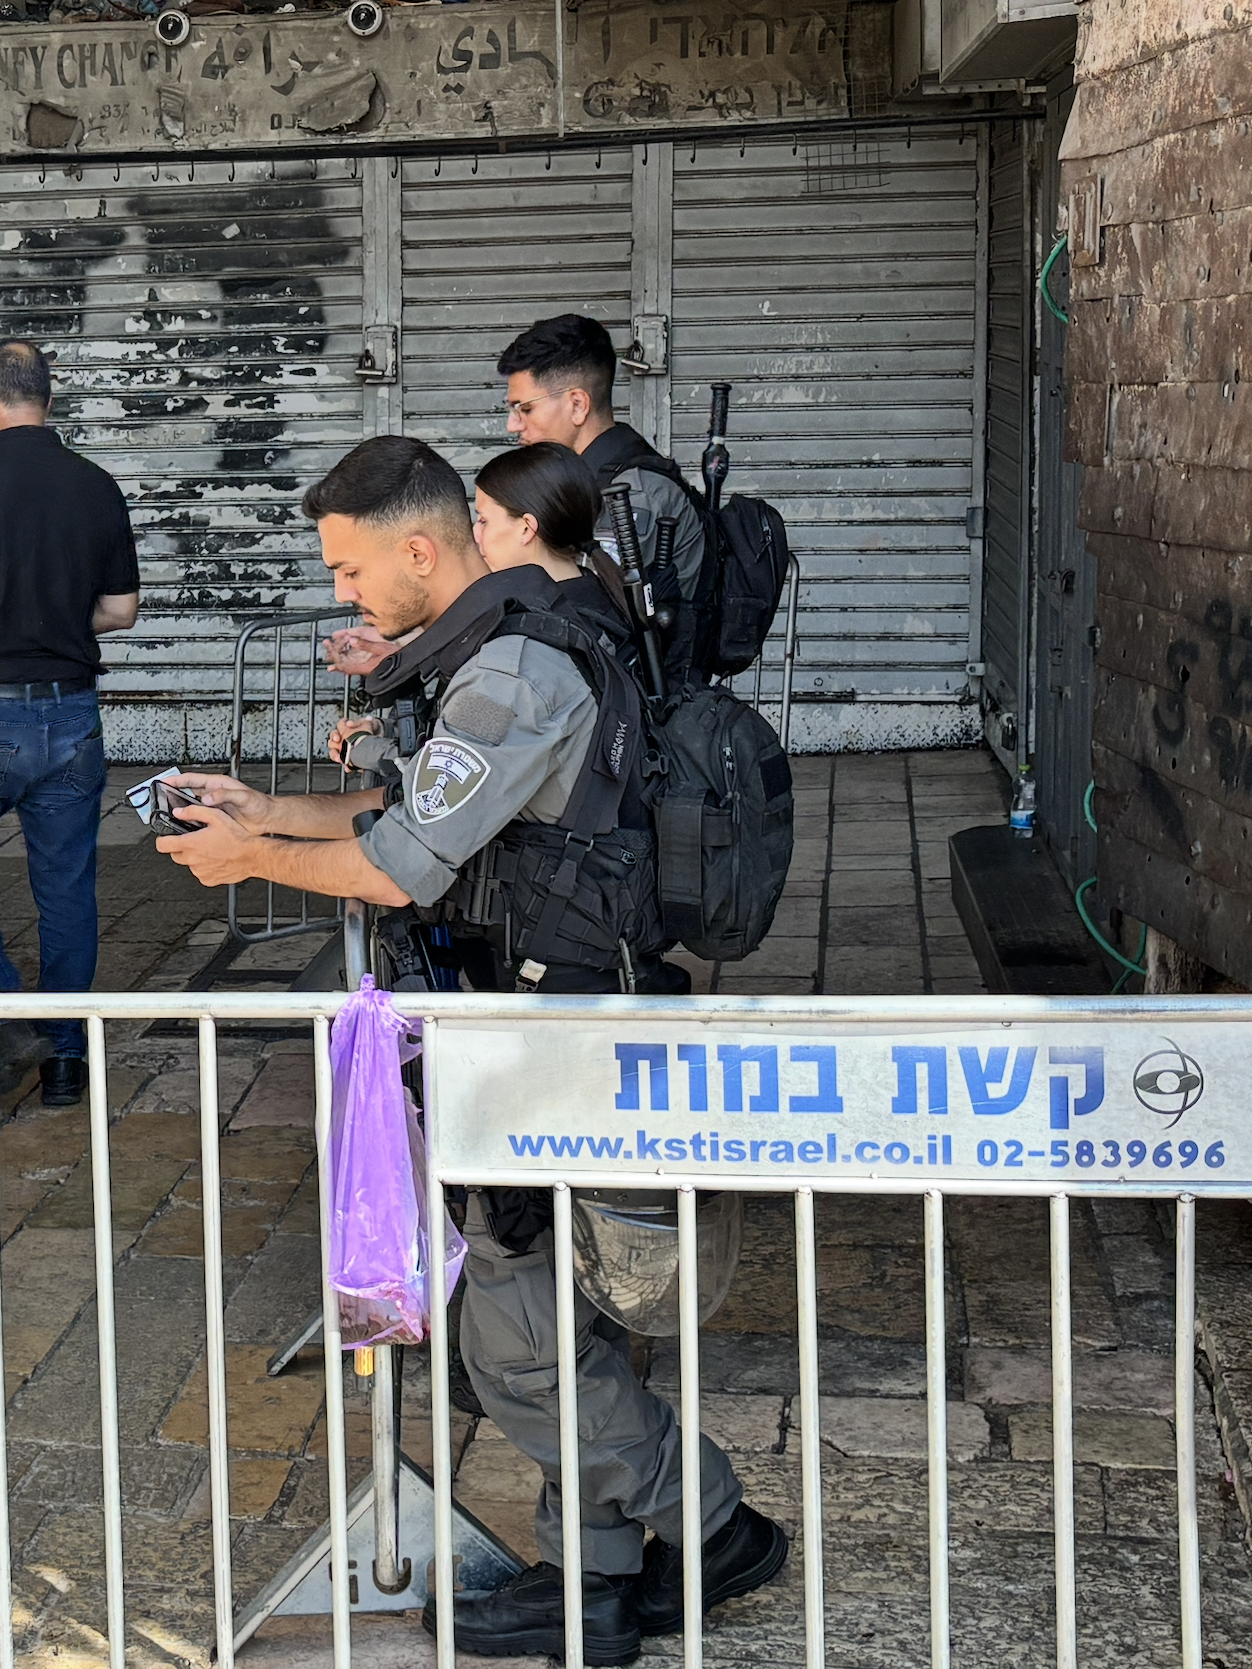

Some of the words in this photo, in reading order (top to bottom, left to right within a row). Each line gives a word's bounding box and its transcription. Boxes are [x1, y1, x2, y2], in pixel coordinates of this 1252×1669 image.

[614, 1043, 844, 1114] במות
[893, 1044, 1105, 1130] קשת
[507, 1132, 952, 1167] www.kstisrael.co.il
[977, 1140, 1227, 1169] 02-5839696
